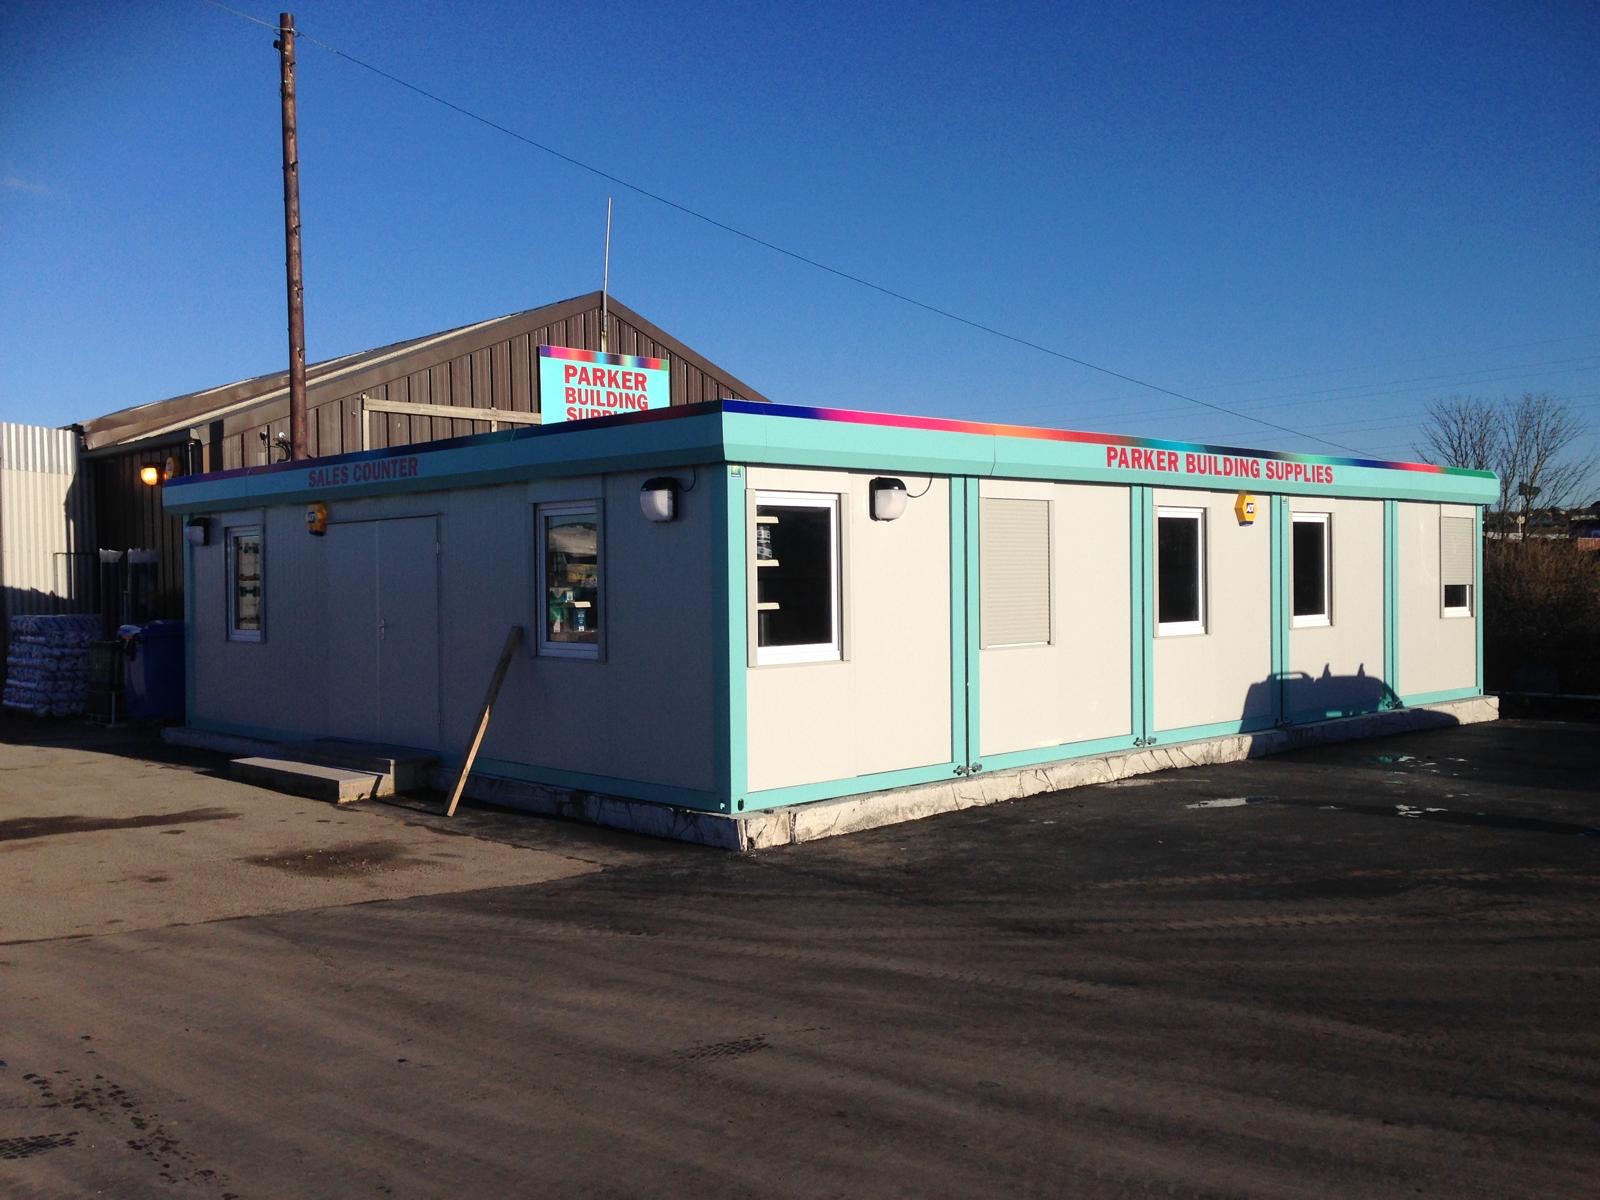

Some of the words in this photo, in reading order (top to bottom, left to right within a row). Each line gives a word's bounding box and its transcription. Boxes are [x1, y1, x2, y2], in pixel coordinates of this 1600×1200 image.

[564, 364, 648, 391] PARKER
[565, 387, 648, 411] BUILDING
[309, 464, 349, 488] SALES
[353, 457, 418, 482] COUNTER
[1106, 446, 1179, 473] PARKER
[1186, 453, 1260, 479] BUILDING
[1265, 460, 1333, 484] SUPPLIES
